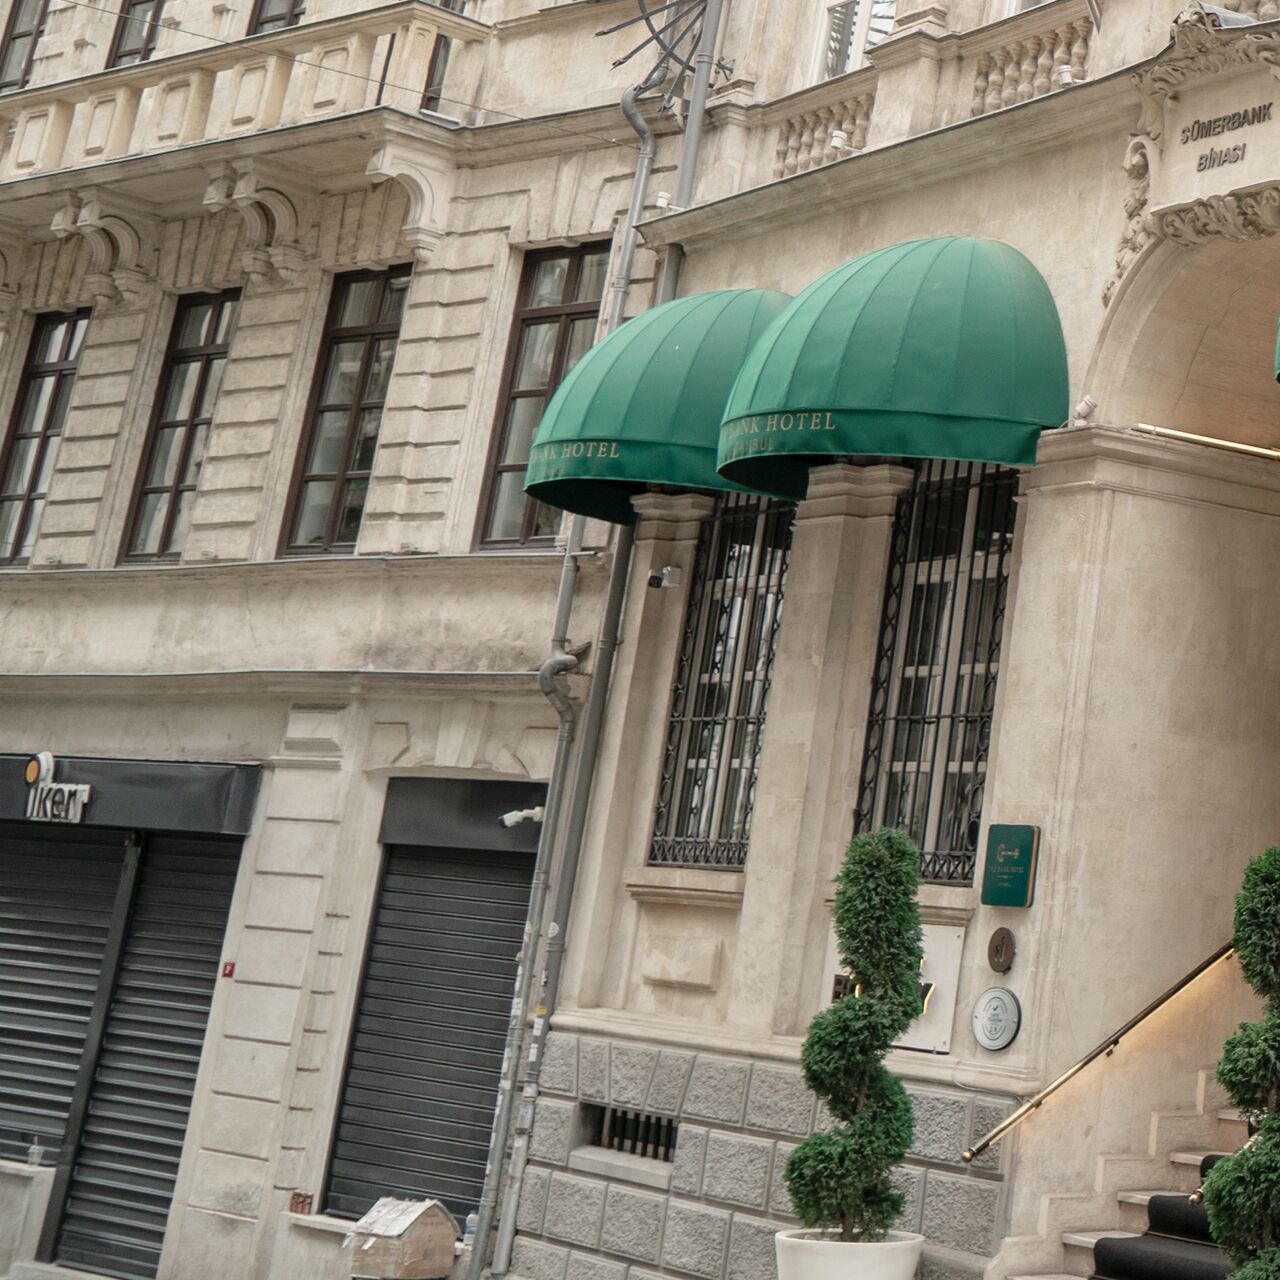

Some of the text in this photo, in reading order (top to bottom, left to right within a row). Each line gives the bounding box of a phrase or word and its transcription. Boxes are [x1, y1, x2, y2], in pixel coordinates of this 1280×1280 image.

[1180, 102, 1274, 144] SÜMERBANK
[1197, 142, 1247, 172] BİNASI
[766, 412, 836, 432] HOTEL
[561, 442, 620, 459] HOTEL
